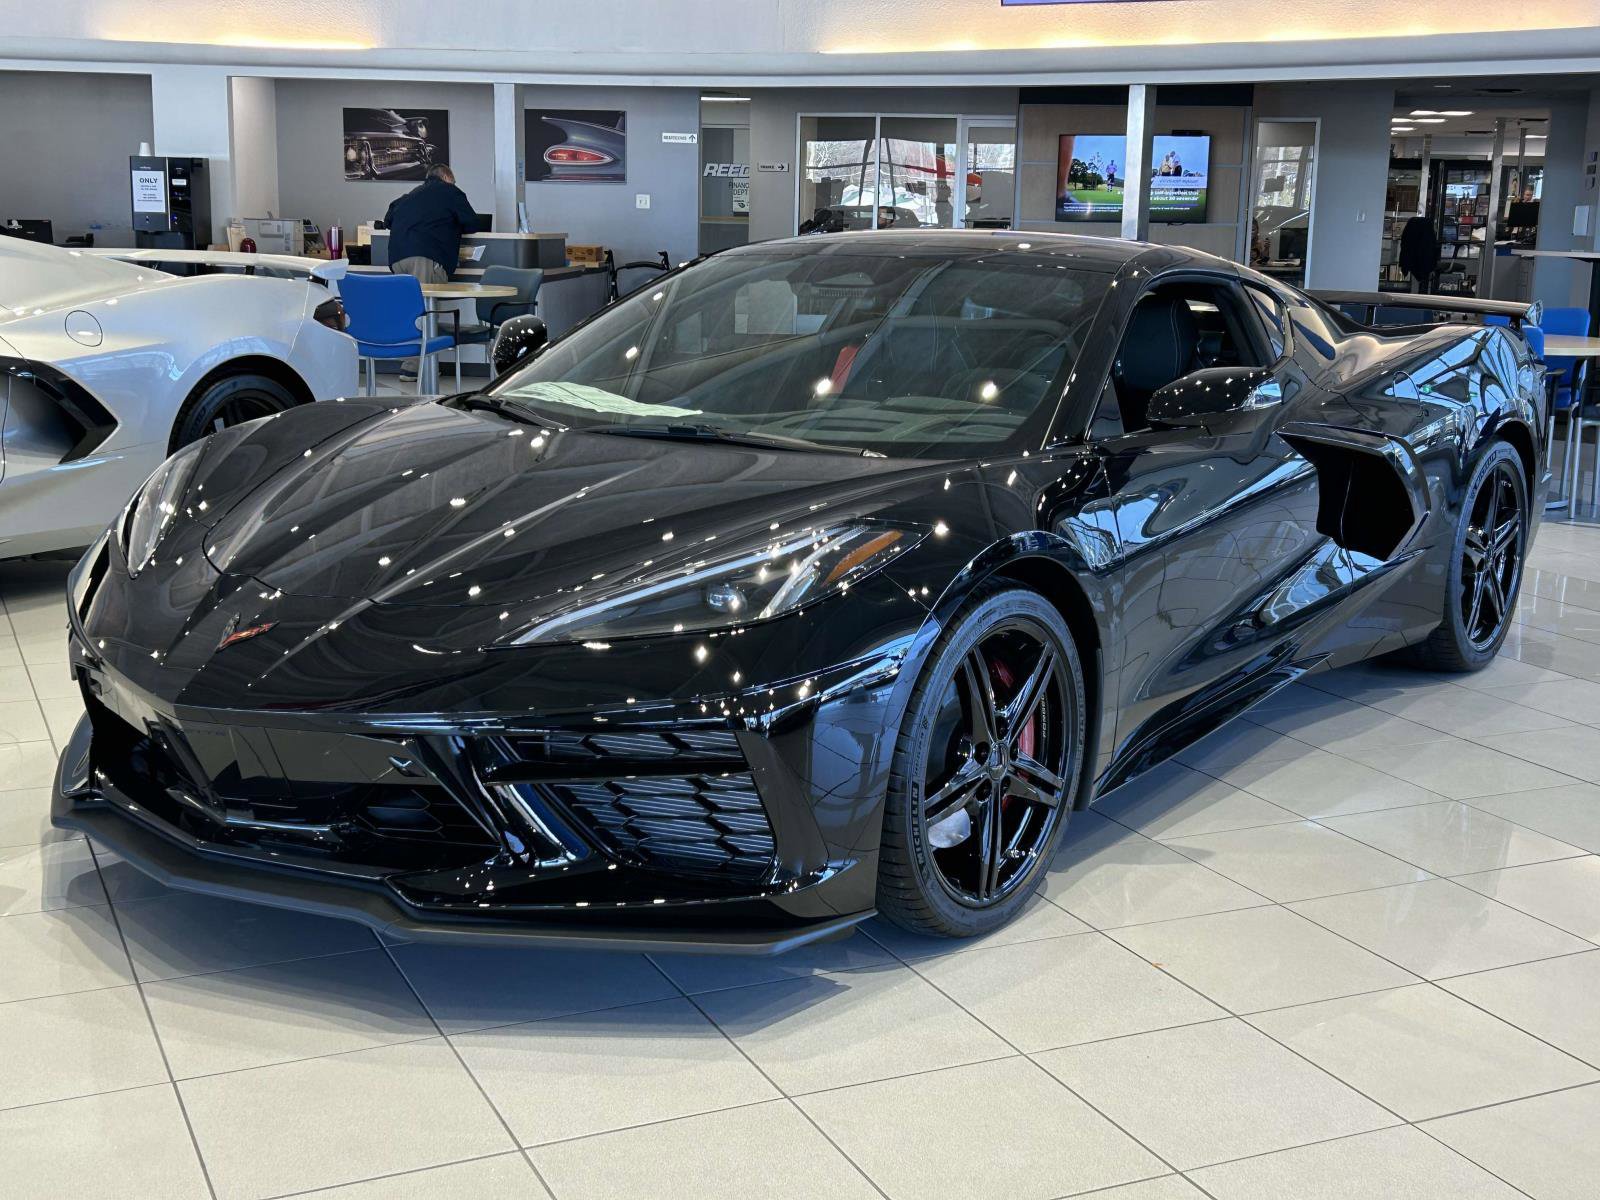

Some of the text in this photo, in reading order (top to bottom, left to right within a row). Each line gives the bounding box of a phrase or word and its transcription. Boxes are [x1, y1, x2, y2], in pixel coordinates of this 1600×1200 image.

[728, 181, 750, 189] FINANC
[733, 188, 748, 196] DEPT
[911, 785, 925, 866] MICHELIN
